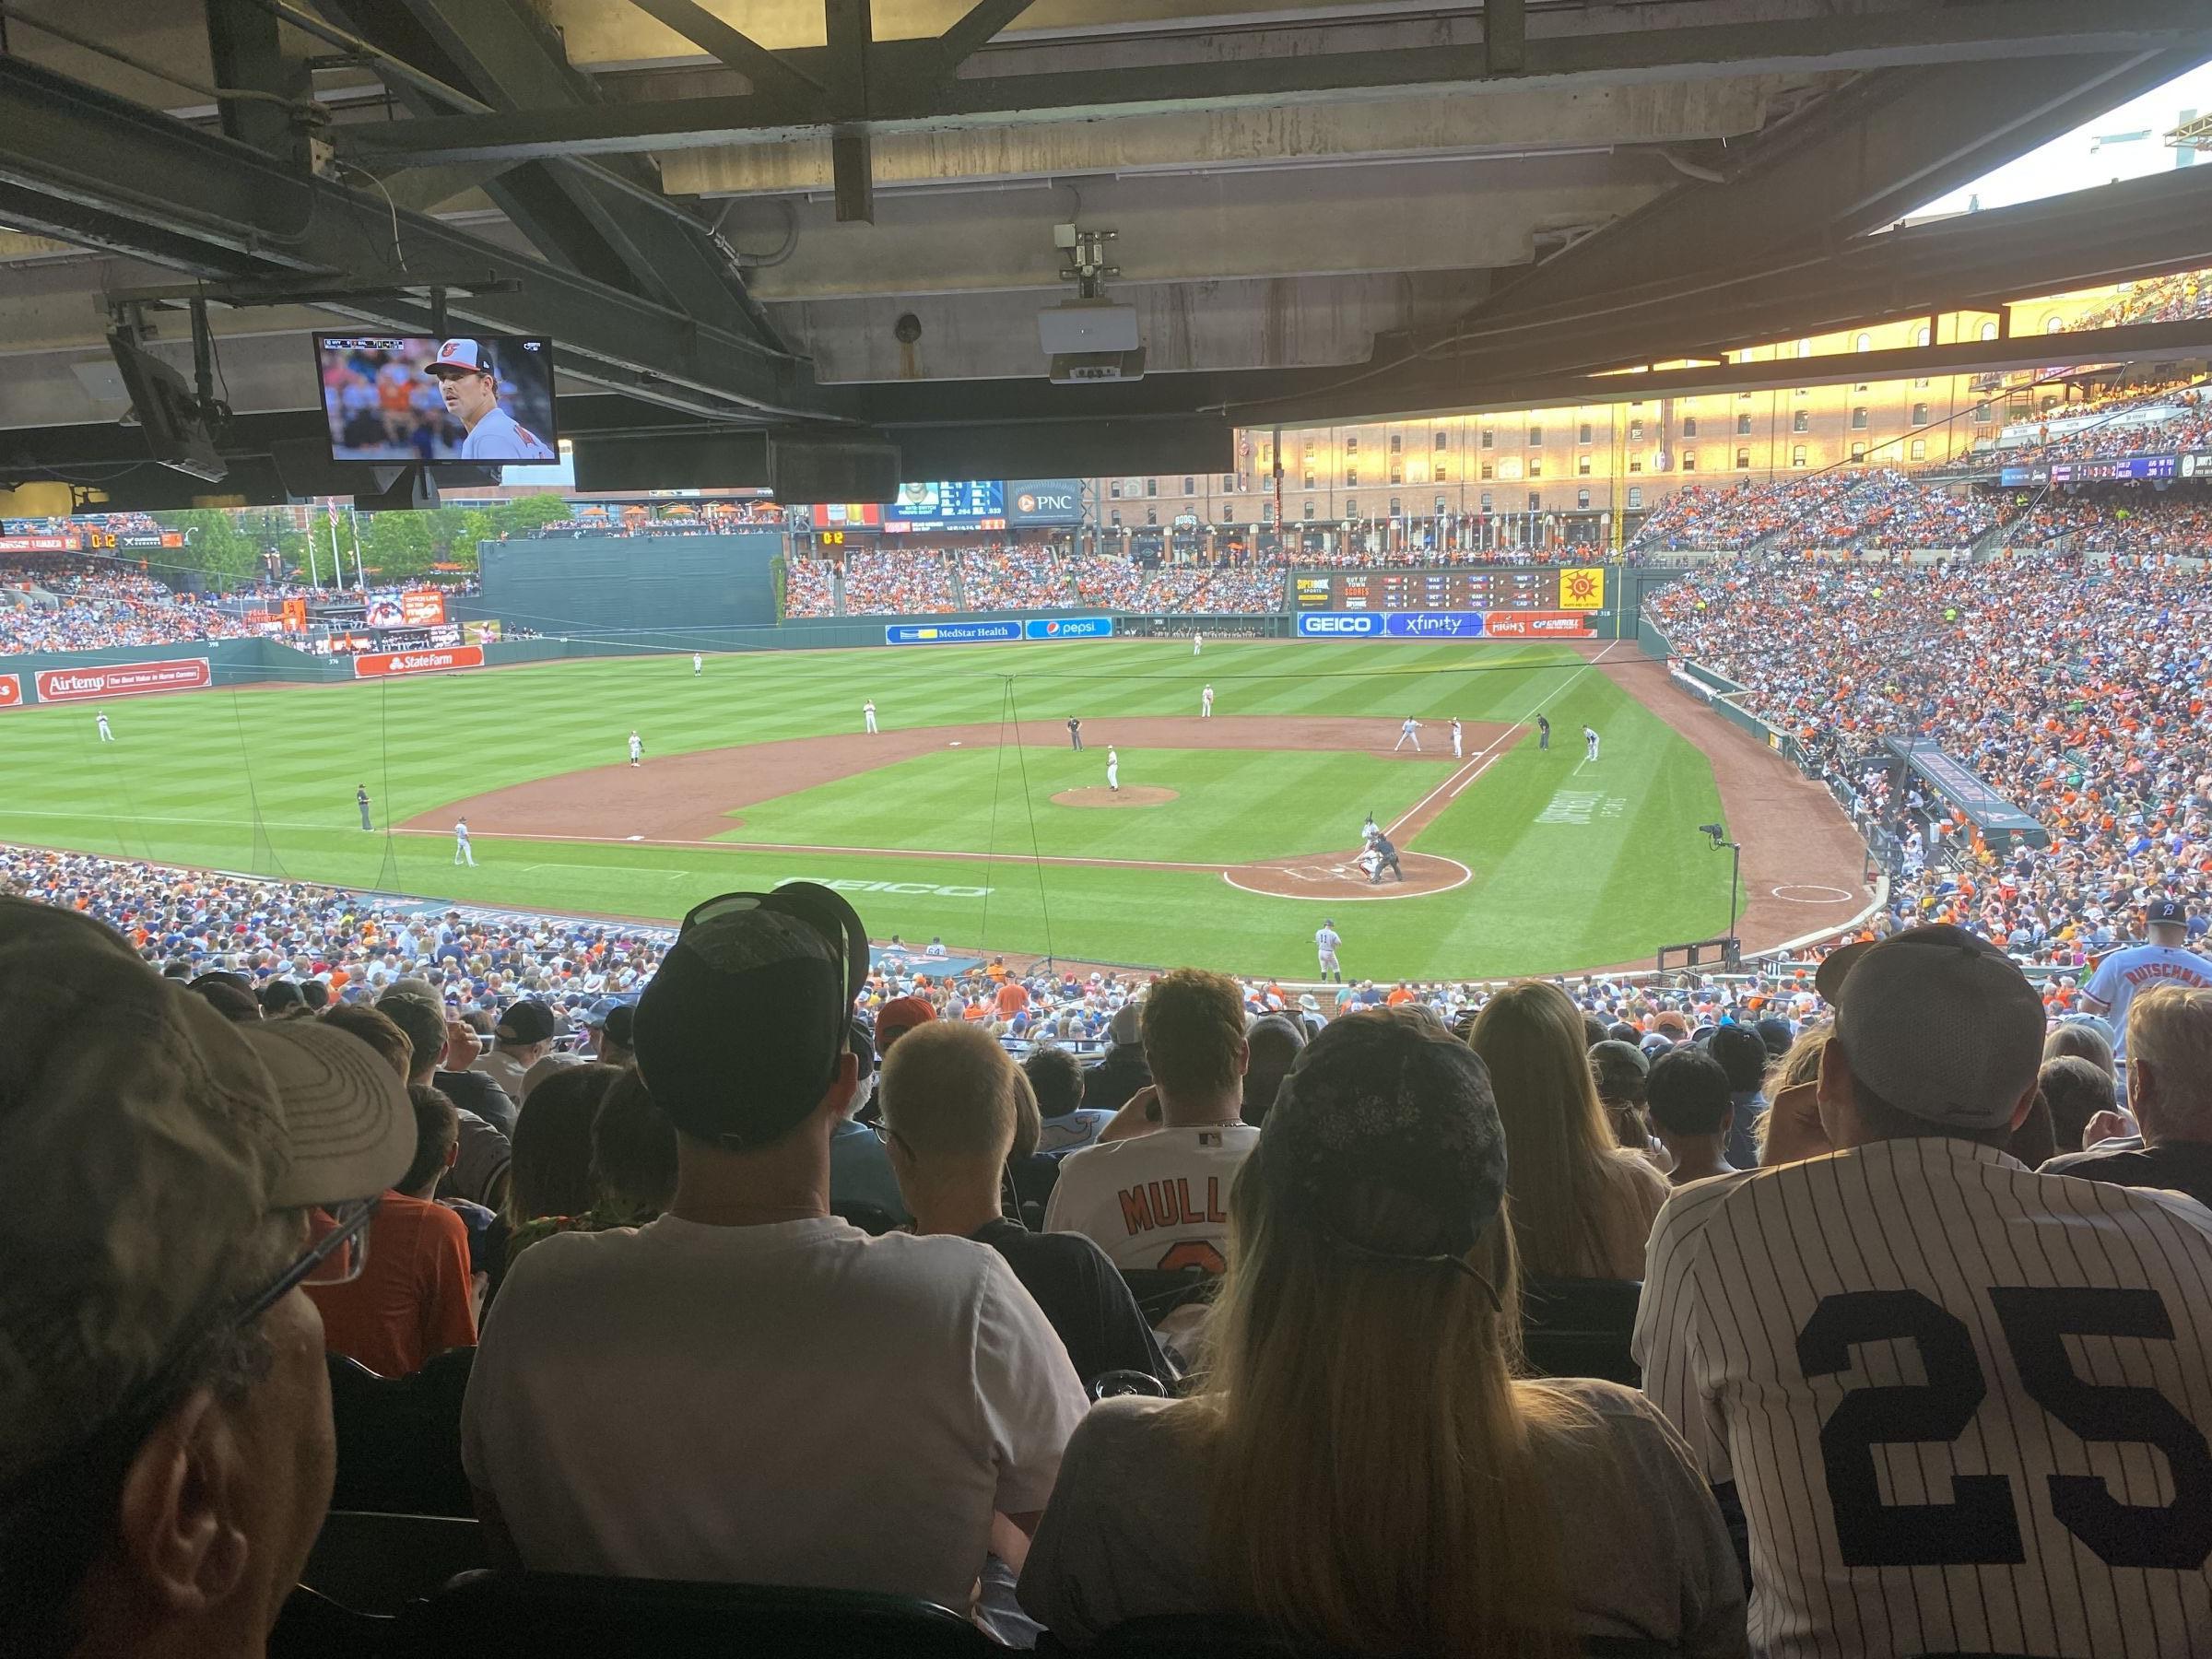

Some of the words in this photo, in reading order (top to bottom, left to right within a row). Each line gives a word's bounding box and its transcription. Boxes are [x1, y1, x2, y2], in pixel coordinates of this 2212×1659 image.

[1036, 495, 1072, 509] PNC
[91, 534, 116, 548] 0:12
[1297, 579, 1330, 590] SUPERBOOK
[1345, 587, 1370, 596] SCORES
[1063, 621, 1095, 634] pepsi
[1305, 617, 1371, 632] GEICO
[1406, 615, 1464, 635] xfinity
[938, 629, 976, 639] MedStar
[978, 627, 1008, 637] Health
[49, 676, 105, 691] Airtemp
[110, 677, 121, 685] The
[121, 675, 135, 684] Best
[135, 674, 151, 683] Value
[159, 672, 174, 681] Home
[2163, 903, 2174, 916] B
[1320, 934, 1327, 944] 11
[1794, 1287, 2212, 1571] 25
